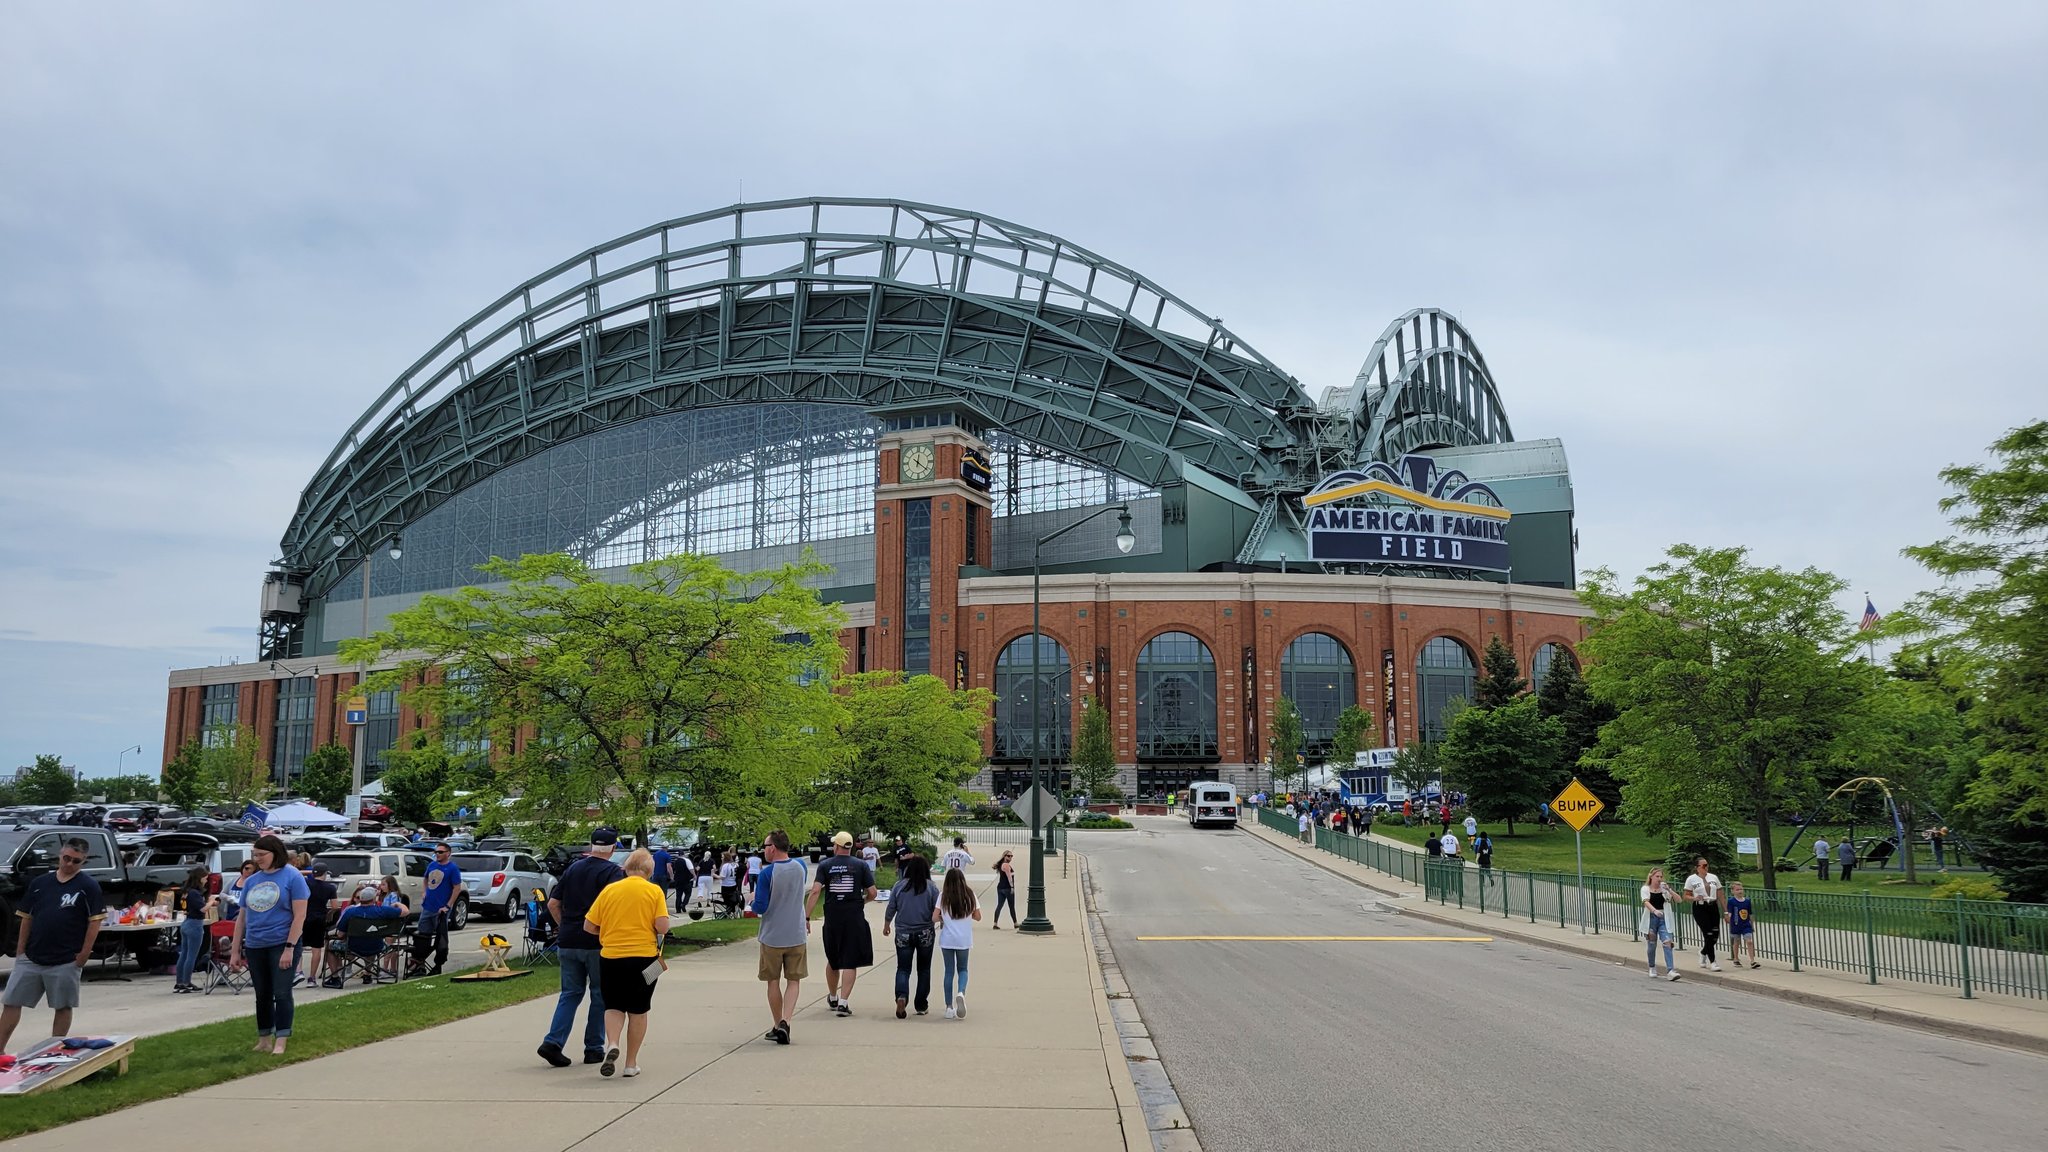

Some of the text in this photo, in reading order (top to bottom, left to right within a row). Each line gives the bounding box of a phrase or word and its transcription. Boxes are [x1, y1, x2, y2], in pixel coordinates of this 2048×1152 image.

[1311, 508, 1507, 541] AMERICAN FAMILY
[1381, 536, 1463, 561] FIELD
[353, 712, 359, 721] 1
[1558, 800, 1597, 812] BUMP
[950, 858, 960, 869] 10
